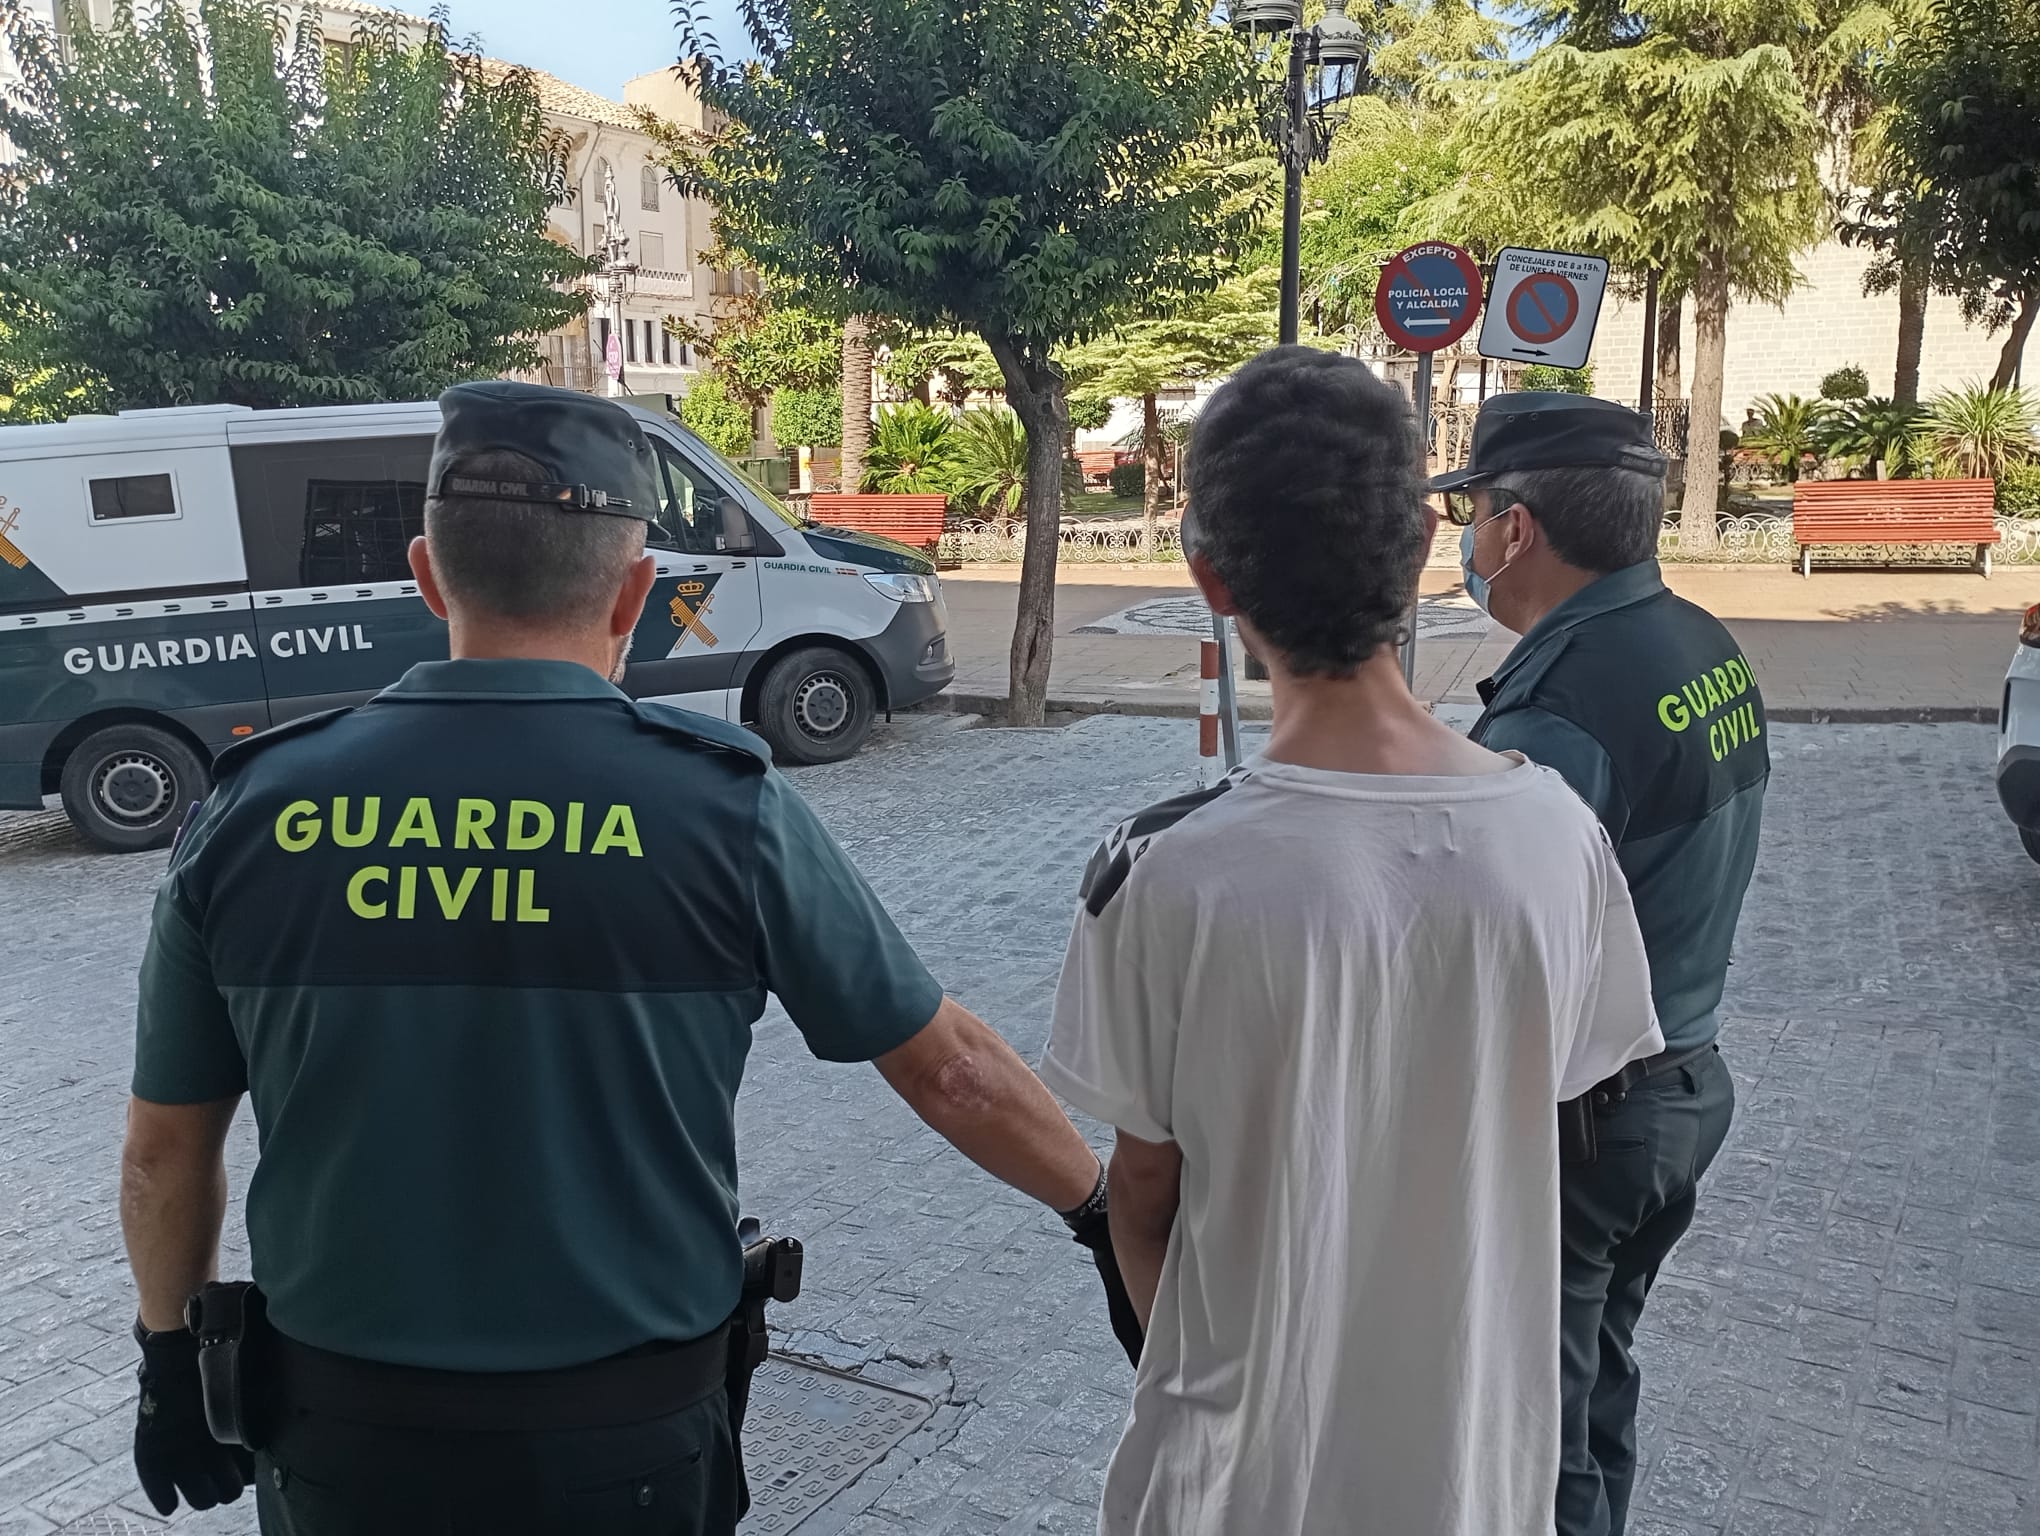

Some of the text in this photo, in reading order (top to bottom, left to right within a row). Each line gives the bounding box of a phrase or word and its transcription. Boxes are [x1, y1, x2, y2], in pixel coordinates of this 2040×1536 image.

[1402, 246, 1457, 263] EXCEPTO
[1506, 254, 1556, 267] CONCEJALES
[1557, 261, 1568, 269] DE
[1521, 265, 1547, 274] LUNES
[1556, 270, 1589, 281] VIERNES
[1433, 287, 1469, 297] LOCAL
[1397, 298, 1459, 310] Y ALCALDÍA
[452, 477, 529, 497] GUARDIA CIVIL
[763, 561, 832, 574] GUARDIA CIVIL
[63, 624, 373, 675] GUARDIA CIVIL
[1657, 654, 1759, 733] GUARDI
[1709, 702, 1761, 762] CIVIL
[275, 796, 644, 857] GUARDIA
[346, 865, 550, 923] CIVIL
